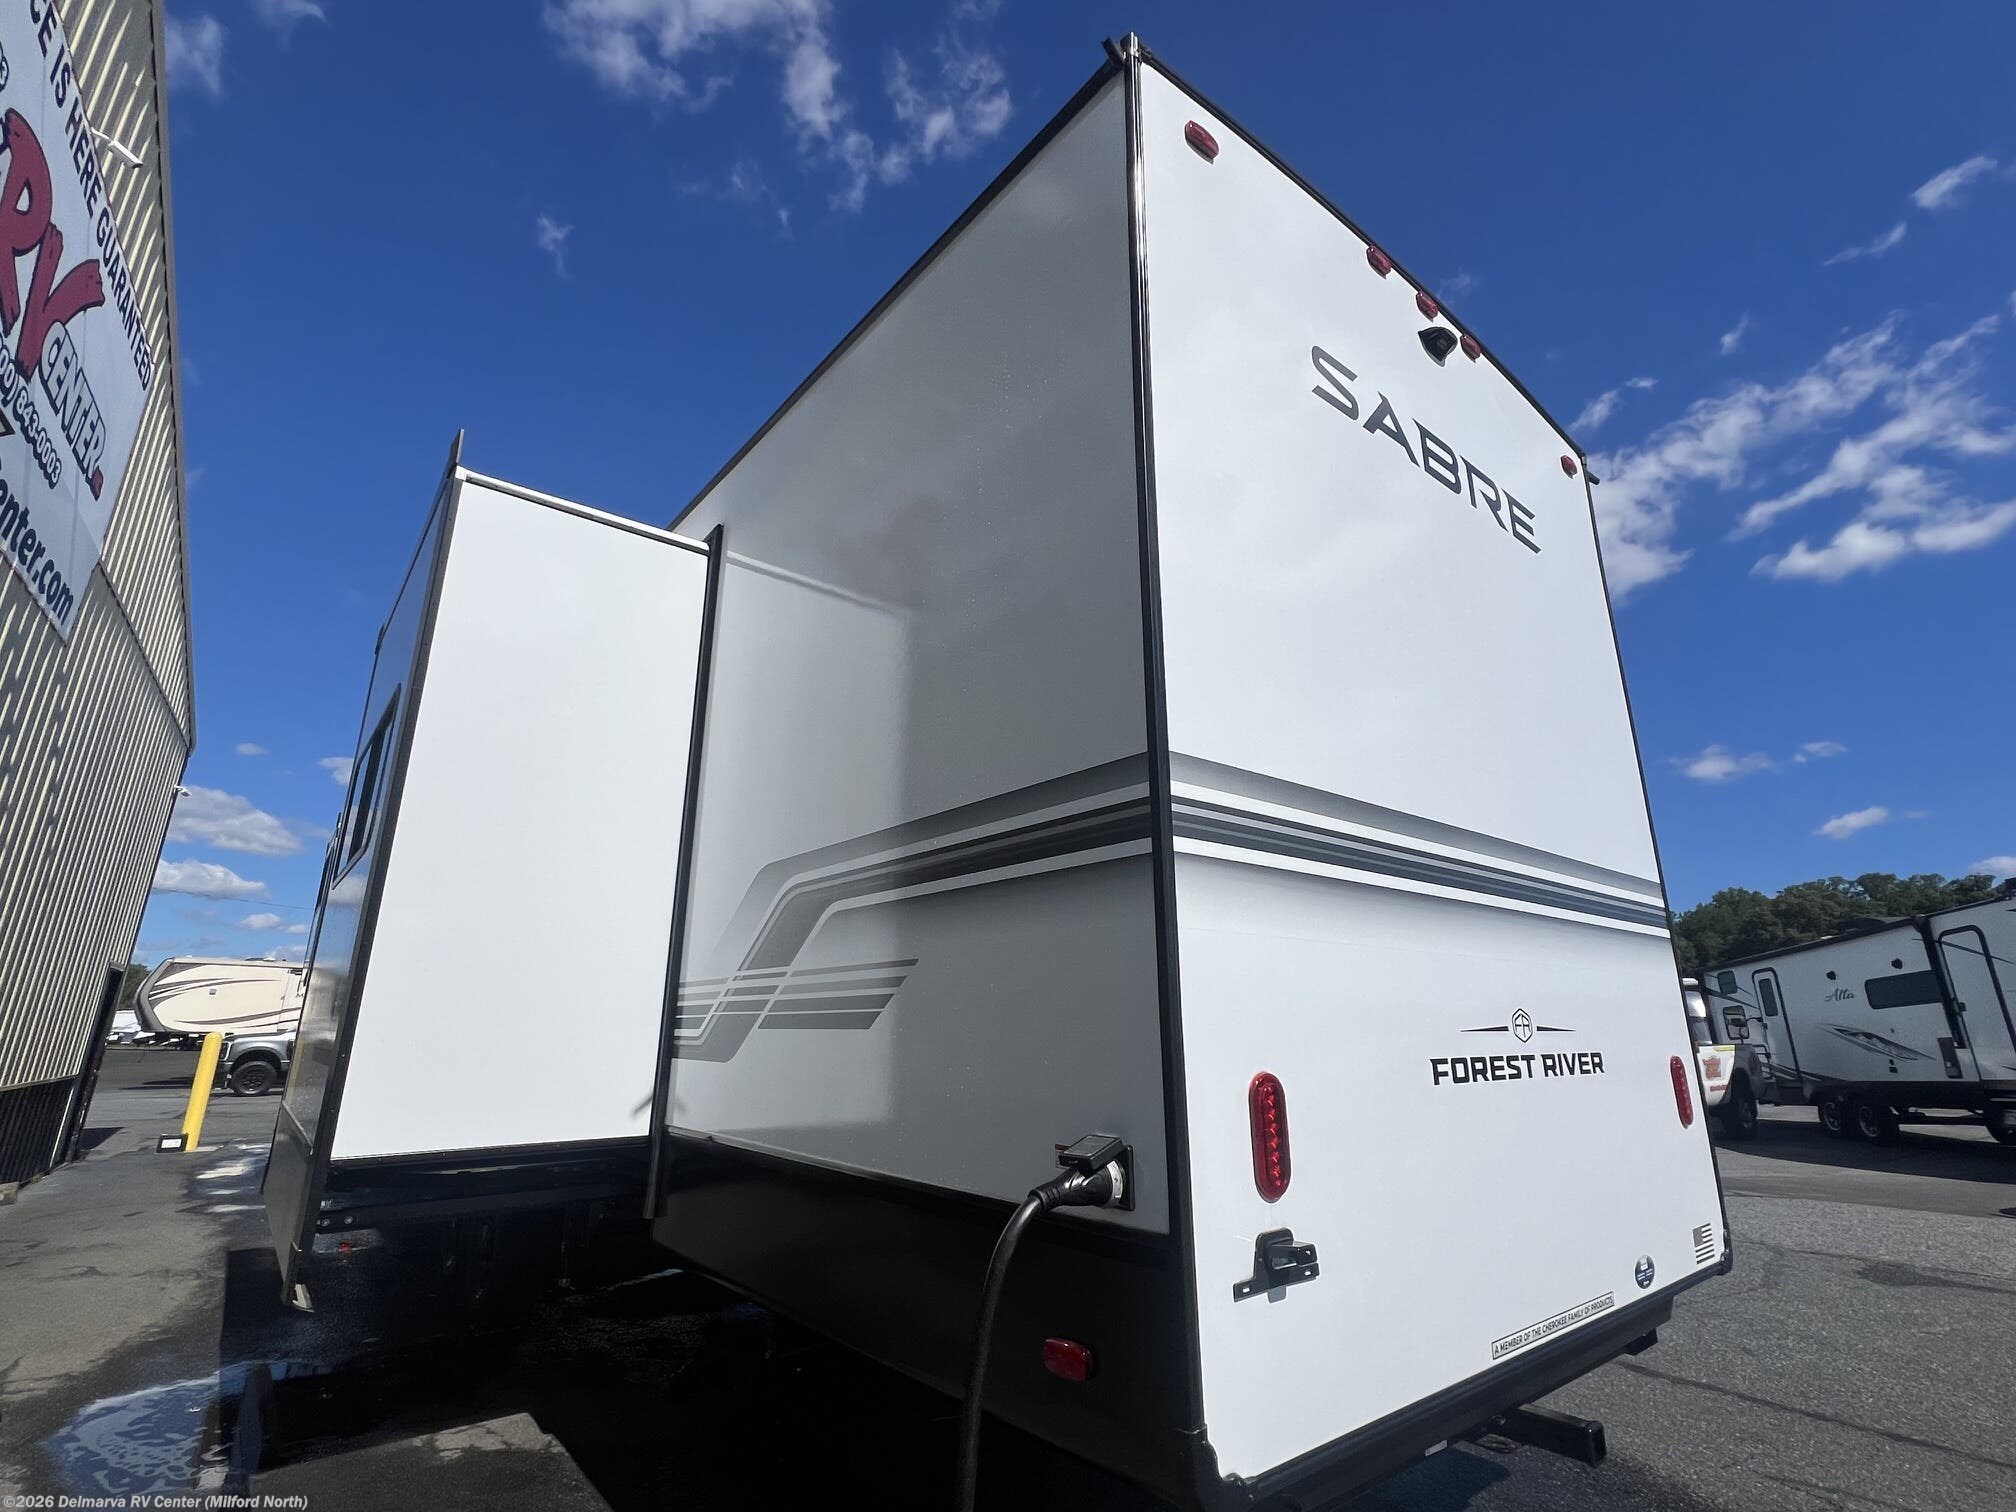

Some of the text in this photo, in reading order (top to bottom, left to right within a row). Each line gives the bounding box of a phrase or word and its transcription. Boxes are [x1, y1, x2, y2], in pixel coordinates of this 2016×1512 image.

[50, 43, 70, 108] IS
[65, 97, 102, 219] HERE
[96, 206, 152, 391] GUARANTEED
[14, 387, 62, 489] 843-0003
[39, 320, 106, 482] CENTER
[1311, 345, 1541, 554] SABRE
[1430, 1052, 1605, 1086] FOREST RIVER
[1494, 1344, 1500, 1355] A
[1500, 1334, 1523, 1351] MEMBER
[1523, 1331, 1531, 1343] OF
[1531, 1326, 1542, 1339] THE
[1542, 1315, 1568, 1334] CHEROKEE
